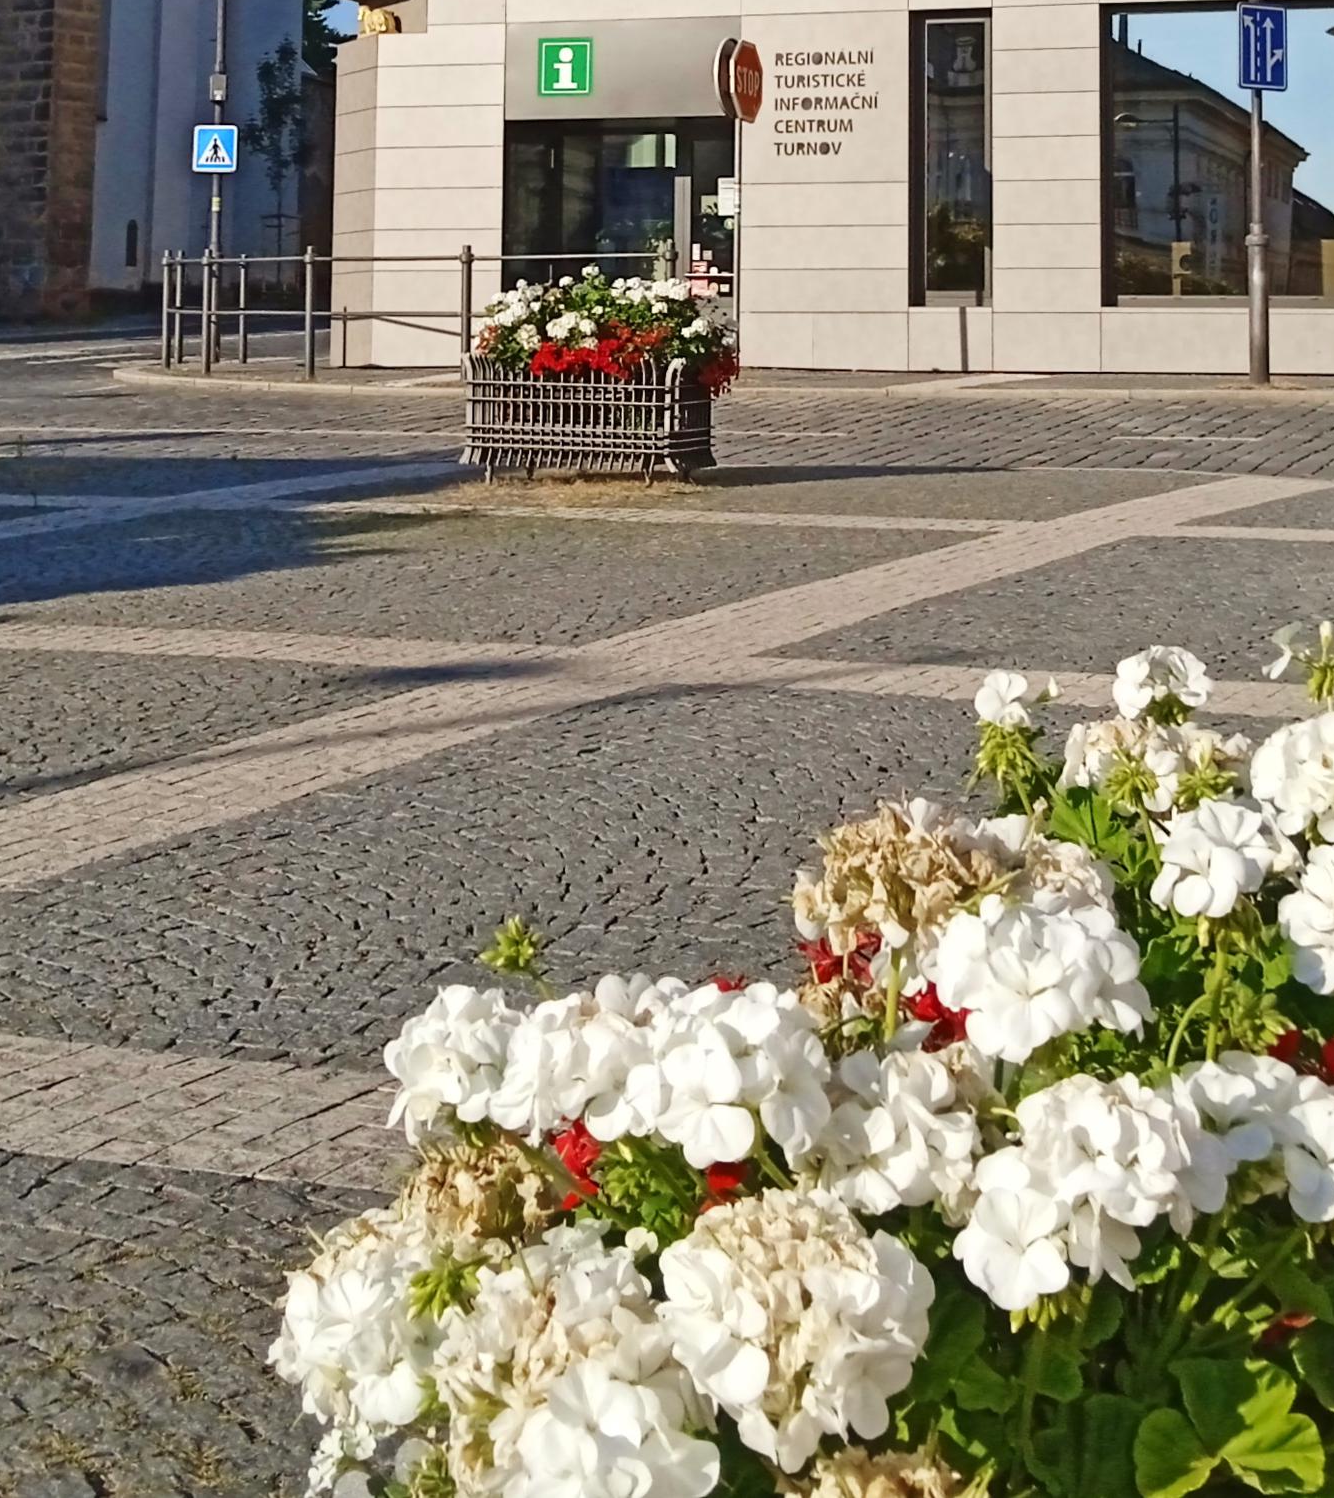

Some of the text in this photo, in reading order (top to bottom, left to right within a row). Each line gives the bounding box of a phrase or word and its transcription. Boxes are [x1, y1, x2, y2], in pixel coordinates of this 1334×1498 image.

[774, 47, 875, 67] REGIONÁLNÍ
[736, 65, 760, 98] STOP
[774, 69, 867, 89] TURISTICKÉ
[774, 91, 880, 112] INFORMAČNÍ
[774, 118, 854, 134] CENTRUM
[773, 141, 843, 157] TURNOV
